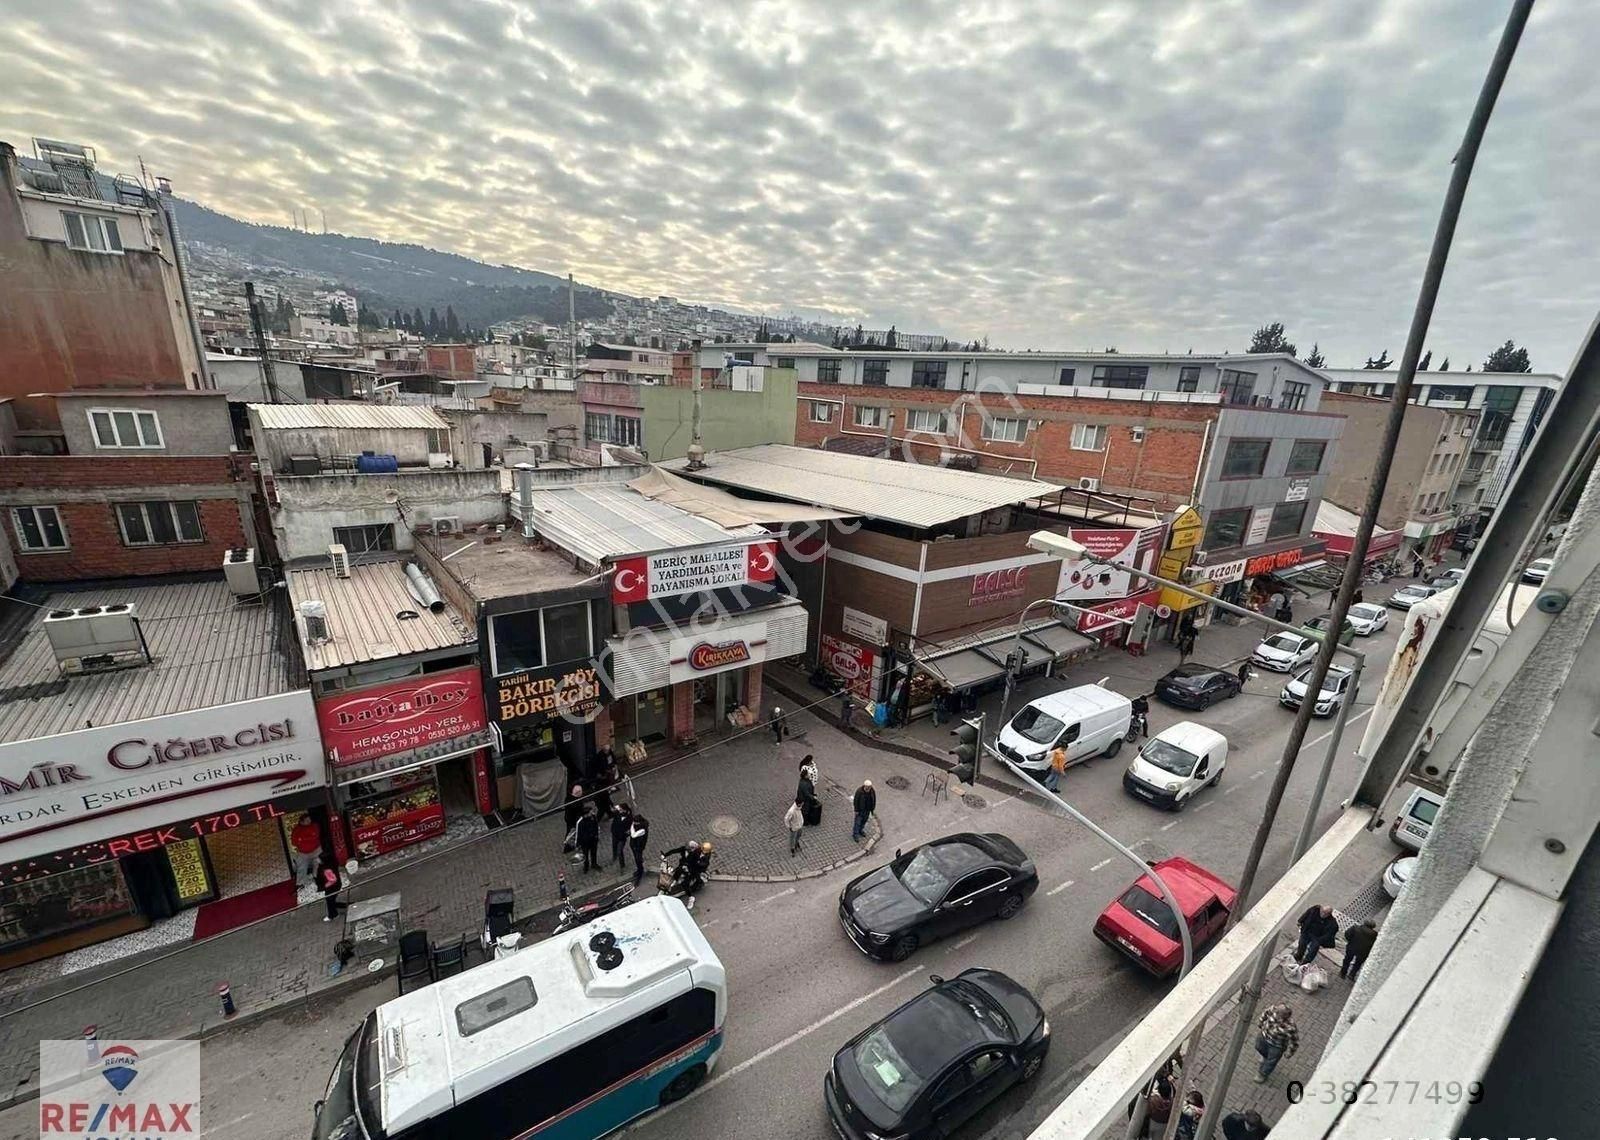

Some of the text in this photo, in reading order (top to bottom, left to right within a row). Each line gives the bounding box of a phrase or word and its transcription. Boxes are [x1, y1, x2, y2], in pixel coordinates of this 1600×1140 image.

[653, 549, 744, 570] MERİÇ MAHALLESİ
[658, 562, 730, 580] YARDIMLAŞMA
[651, 577, 710, 594] DAYANIŞMA
[499, 668, 597, 703] BAKIR KÖY
[500, 674, 529, 687] TARİHİ
[338, 688, 470, 726] battalbey
[500, 680, 600, 721] BÖREKÇİSİ
[352, 723, 431, 749] HEMŞO'NUN
[82, 777, 183, 810] ESKEMEN
[192, 812, 241, 835] 170
[247, 803, 285, 822] TL
